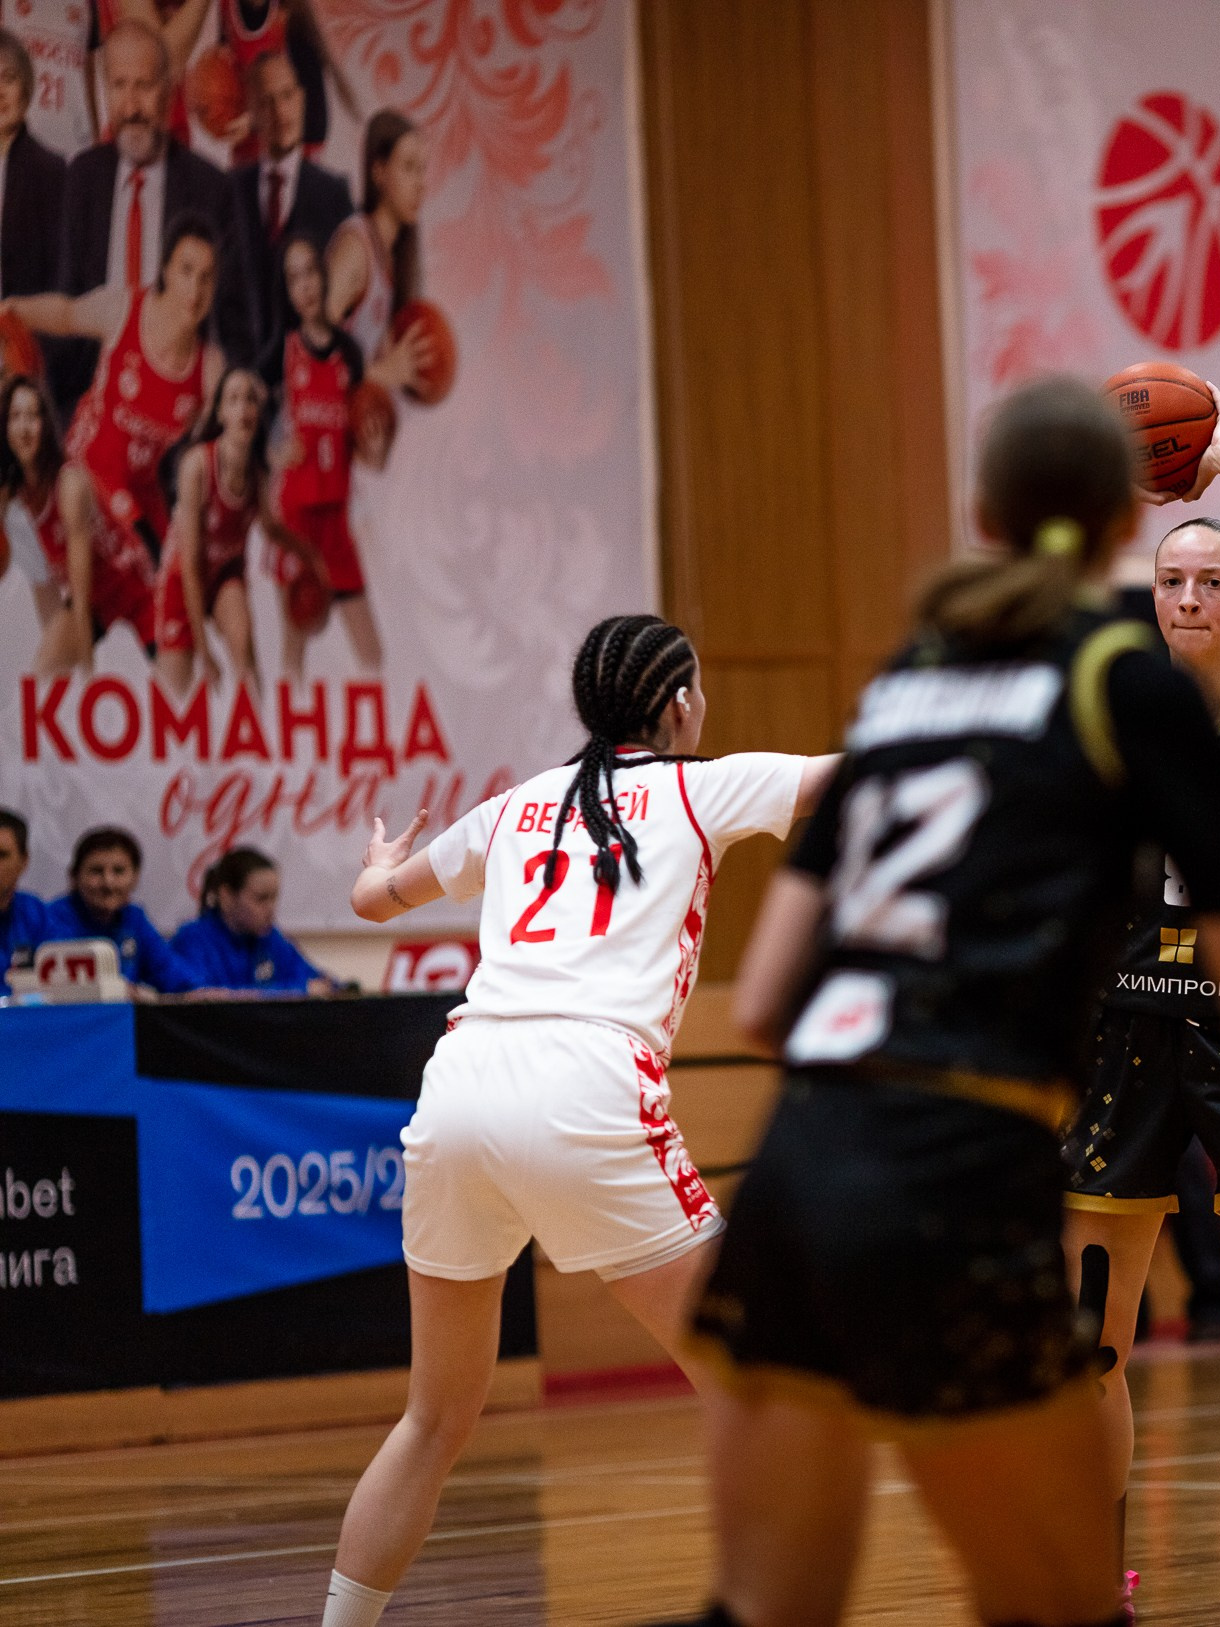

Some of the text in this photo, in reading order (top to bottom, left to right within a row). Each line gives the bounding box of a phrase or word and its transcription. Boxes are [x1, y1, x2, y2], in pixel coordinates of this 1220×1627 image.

[1119, 389, 1150, 408] FIBA
[20, 675, 450, 779] КОМАНДА
[510, 843, 624, 945] 21
[0, 1166, 76, 1220] bet
[230, 1145, 405, 1219] 2025/2
